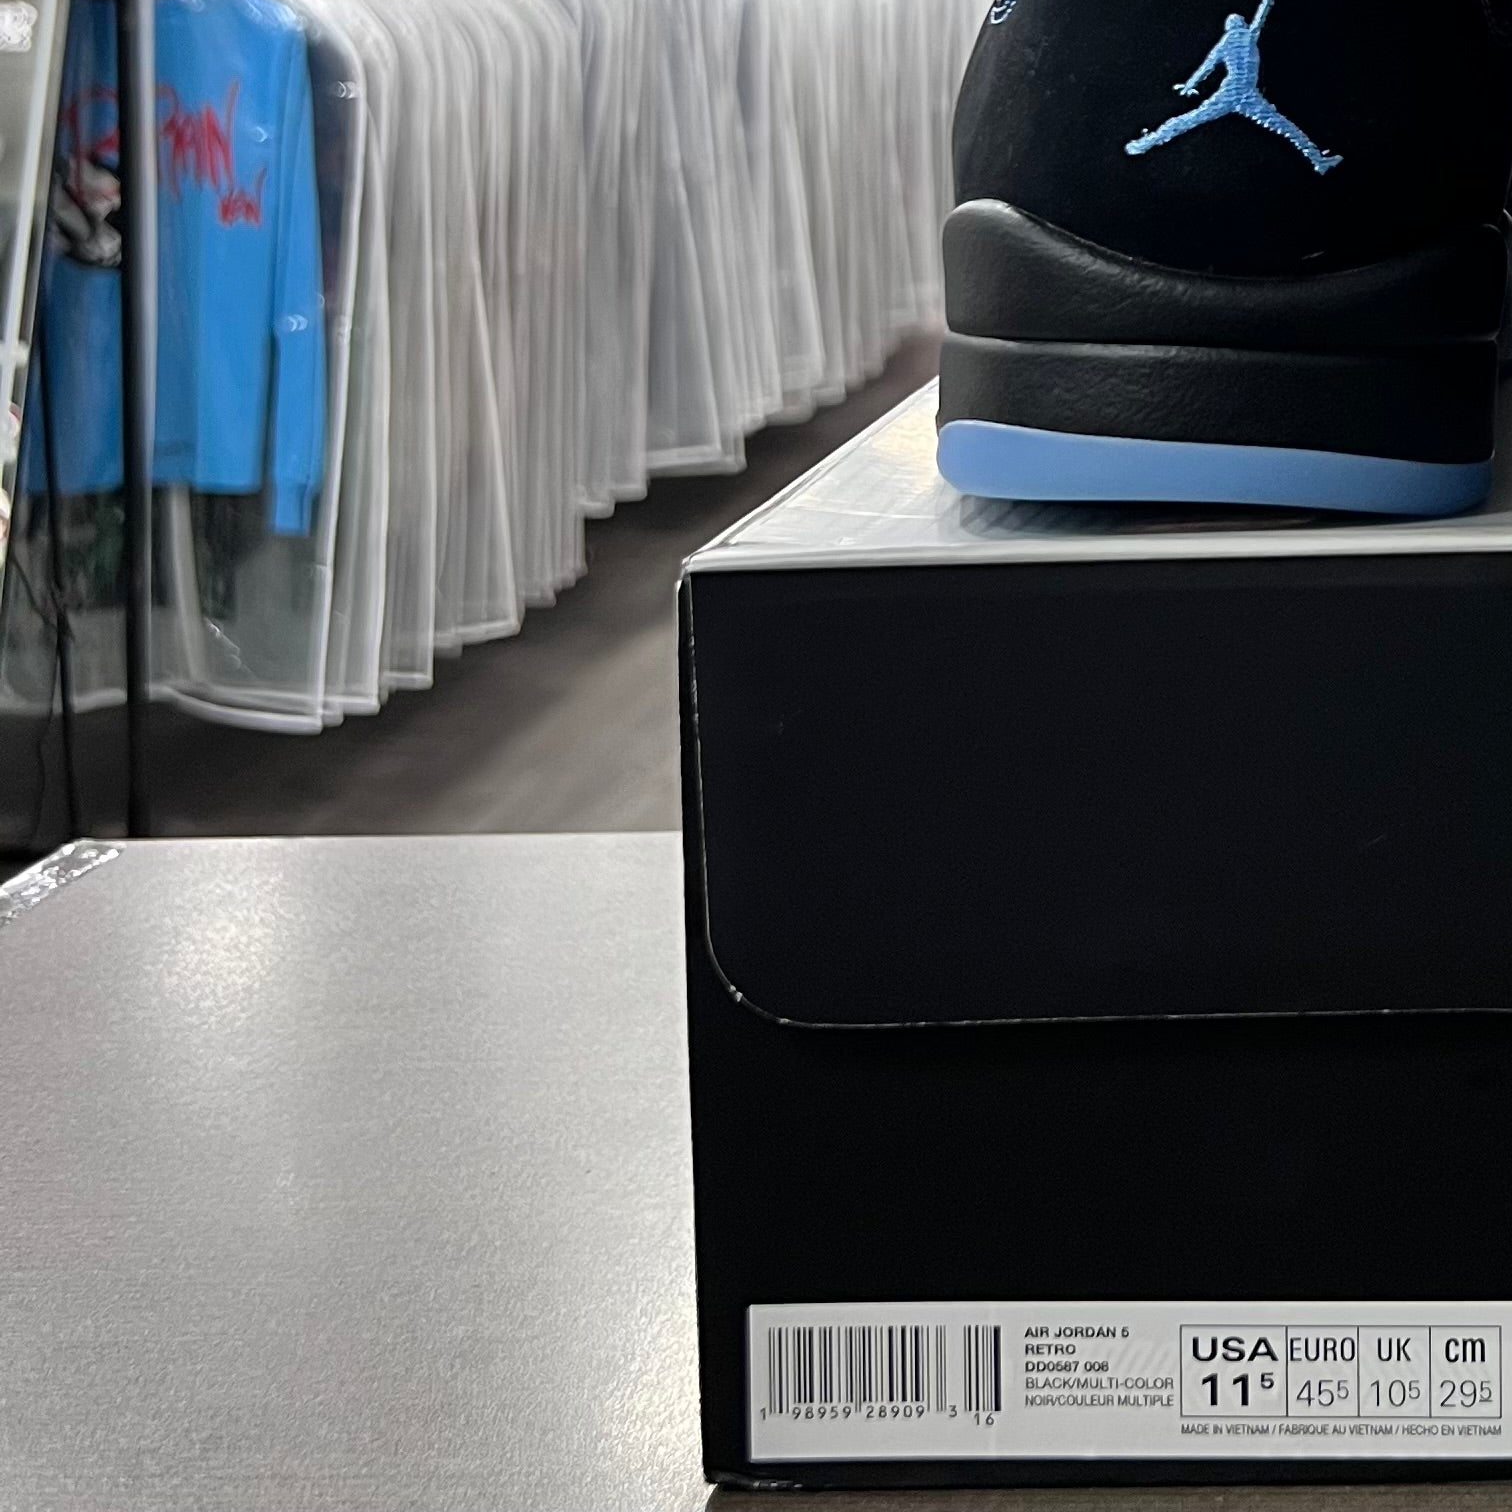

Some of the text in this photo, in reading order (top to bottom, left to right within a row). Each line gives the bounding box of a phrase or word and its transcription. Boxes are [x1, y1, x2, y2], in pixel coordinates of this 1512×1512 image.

[1024, 1326, 1050, 1339] AIR
[1054, 1326, 1117, 1339] JORDAN
[1024, 1343, 1077, 1356] RETRO
[1192, 1336, 1487, 1364] USA EURO UK cm
[1025, 1376, 1175, 1390] BLACK/MULTI-COLOR
[1024, 1393, 1175, 1407] NOIR/COULEUR MULTIPLE
[792, 1405, 852, 1420] 98959
[866, 1404, 926, 1419] 28909
[949, 1405, 958, 1419] 3
[974, 1413, 995, 1426] 16
[1181, 1424, 1210, 1435] MADE
[1213, 1424, 1223, 1435] IN
[1225, 1424, 1270, 1435] VIETNAM
[1279, 1424, 1330, 1436] FABRIQUE
[1332, 1424, 1347, 1435] AU
[1349, 1424, 1393, 1436] VIETNAM
[1402, 1424, 1439, 1436] HECHO
[1441, 1424, 1455, 1436] EN
[1458, 1425, 1502, 1436] VIETNAM
